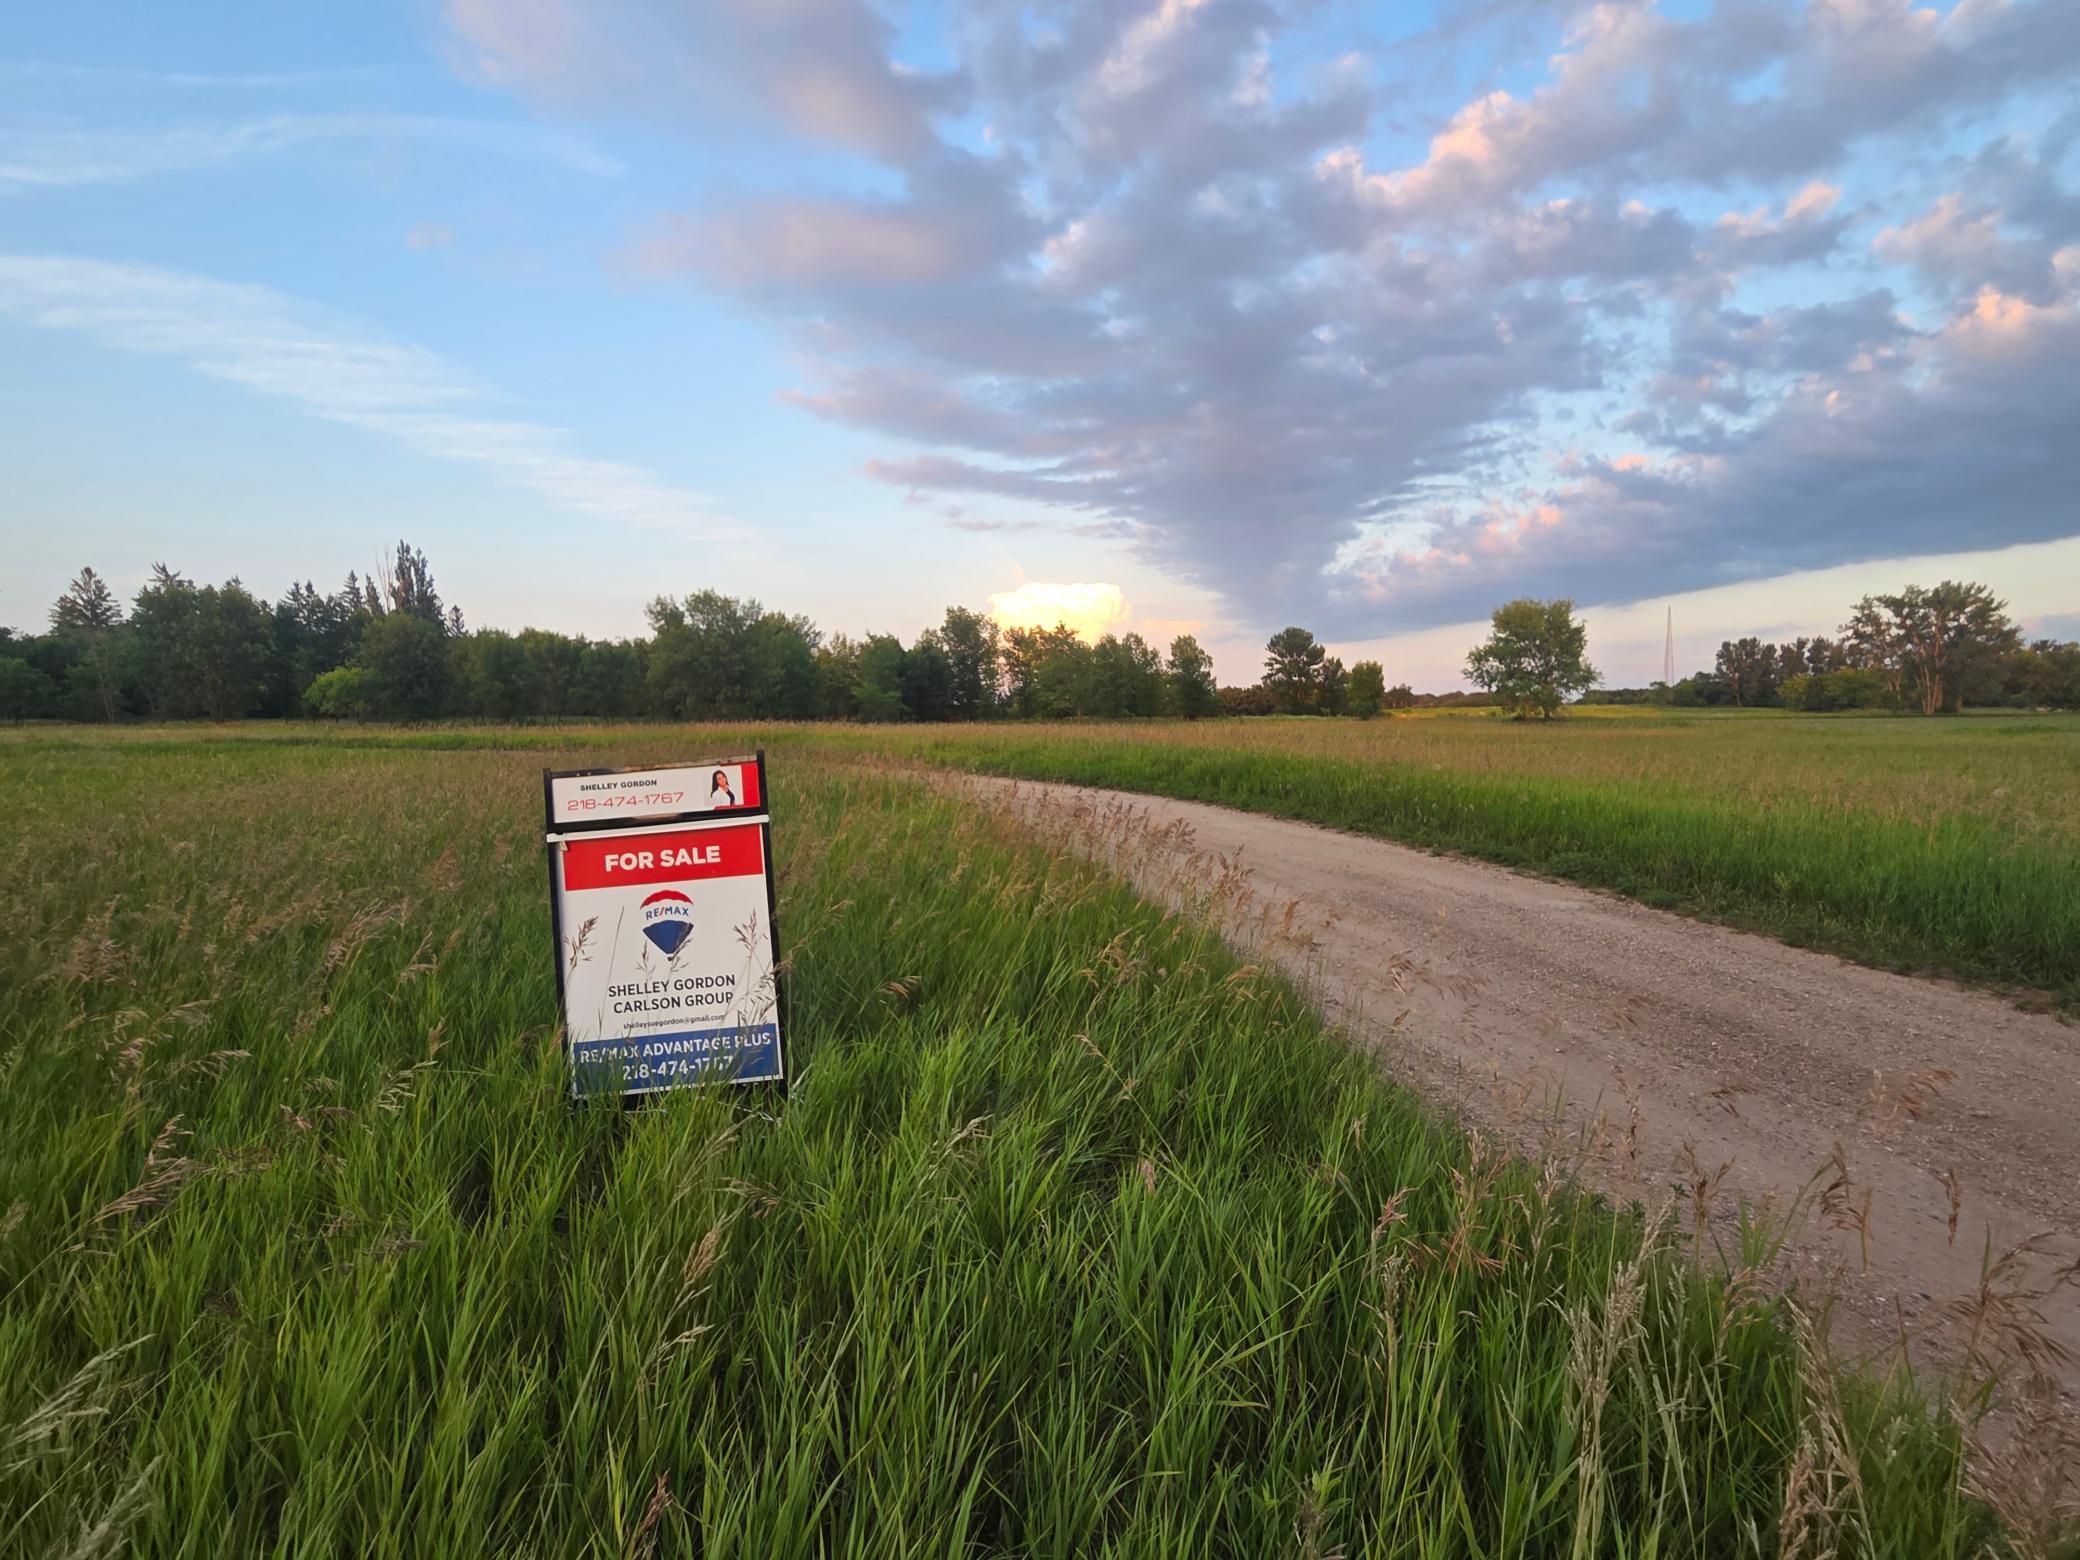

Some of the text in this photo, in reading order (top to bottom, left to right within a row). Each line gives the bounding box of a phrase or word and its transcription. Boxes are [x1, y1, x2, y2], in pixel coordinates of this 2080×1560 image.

[580, 780, 657, 791] SHELLEY GORDON
[568, 791, 684, 810] 218-474-1767
[605, 845, 721, 872] FOR SALE
[645, 905, 689, 920] RE/MAX
[608, 974, 735, 997] SHELLEY GORDON
[613, 991, 734, 1014] CARLSON GROUP
[643, 1036, 731, 1057] ADVANTAGE
[734, 1032, 771, 1049] PLUS
